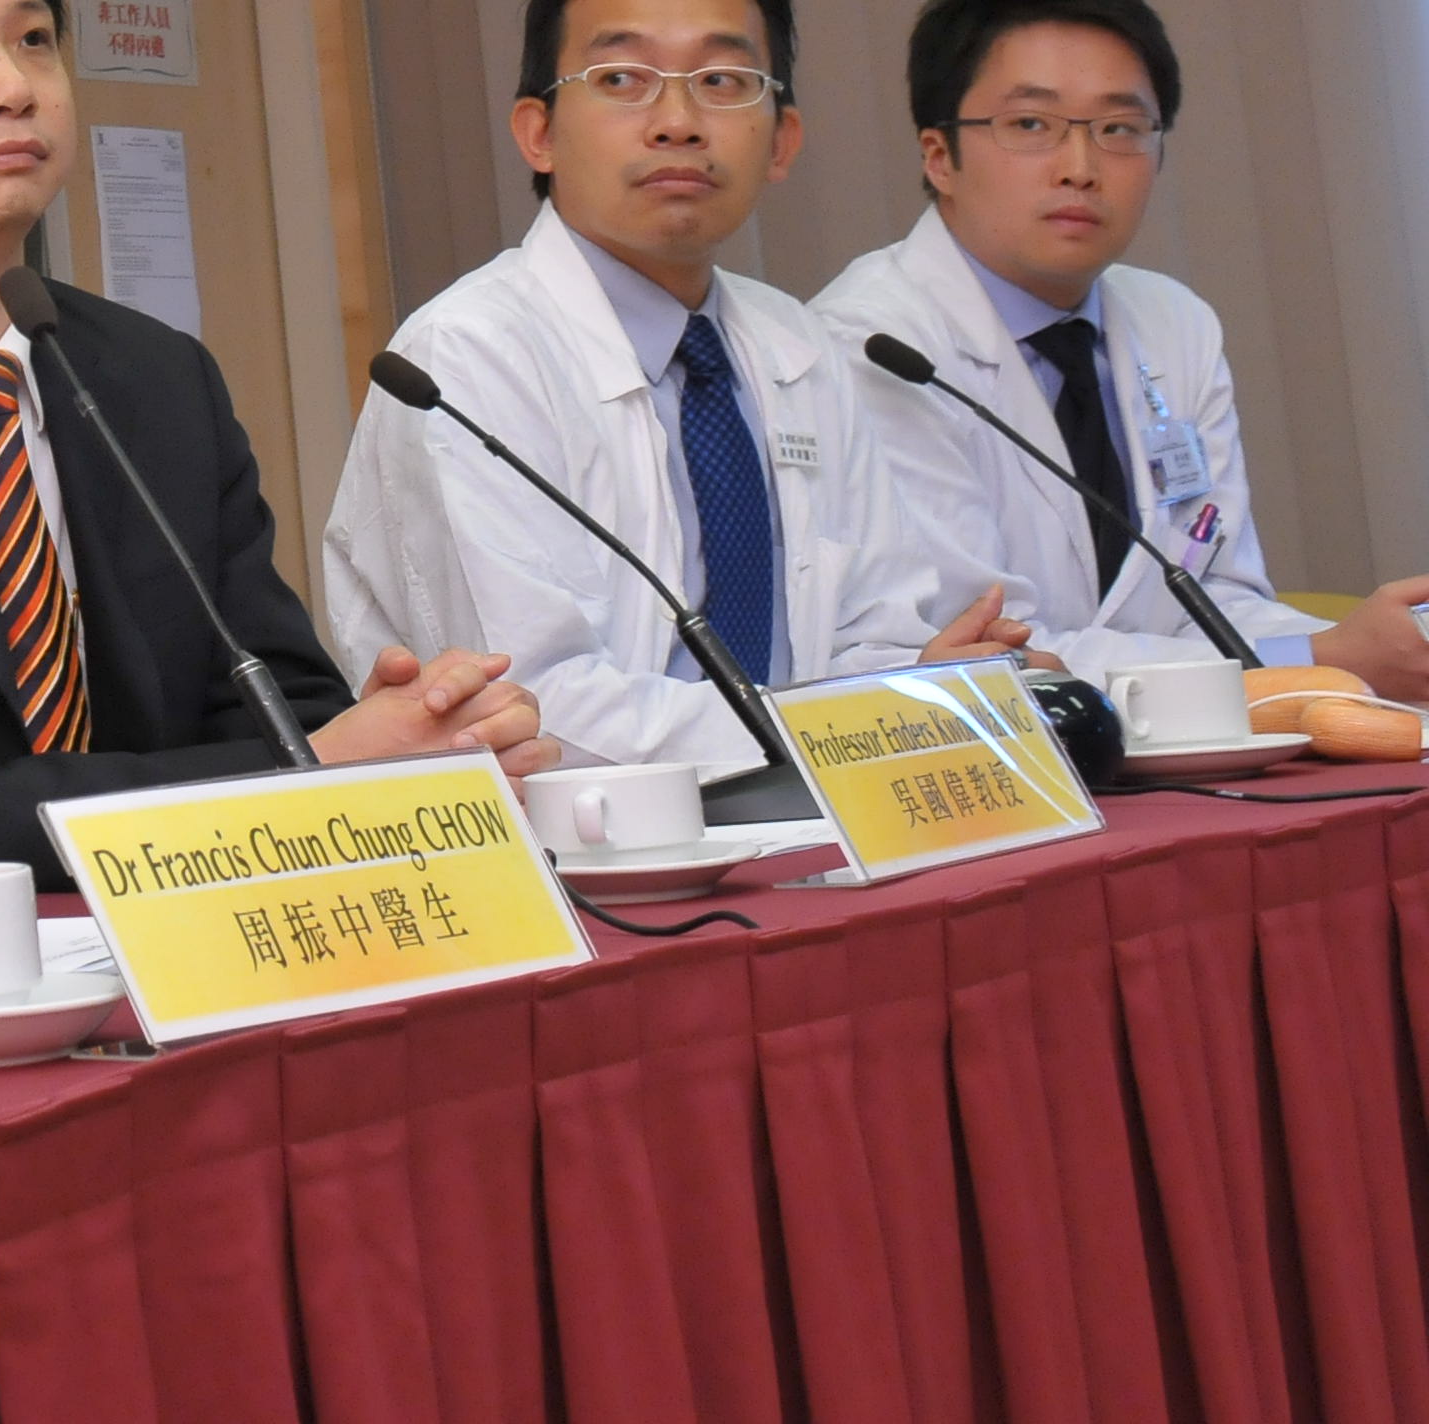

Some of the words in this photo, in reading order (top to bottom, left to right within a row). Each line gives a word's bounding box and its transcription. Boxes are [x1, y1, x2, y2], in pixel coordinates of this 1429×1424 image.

[98, 1, 171, 30] 非工作人員
[799, 723, 886, 768] Professor
[877, 712, 938, 752] Enders
[927, 709, 981, 745] Kwo
[996, 698, 1033, 732] NG
[891, 761, 1024, 828] 吳國偉教授
[93, 847, 138, 897] Dr
[140, 830, 251, 891] Francis
[248, 819, 331, 875] Chun
[327, 812, 426, 870] Chung
[415, 799, 510, 852] CHOW
[233, 882, 469, 972] 周振中醫生
